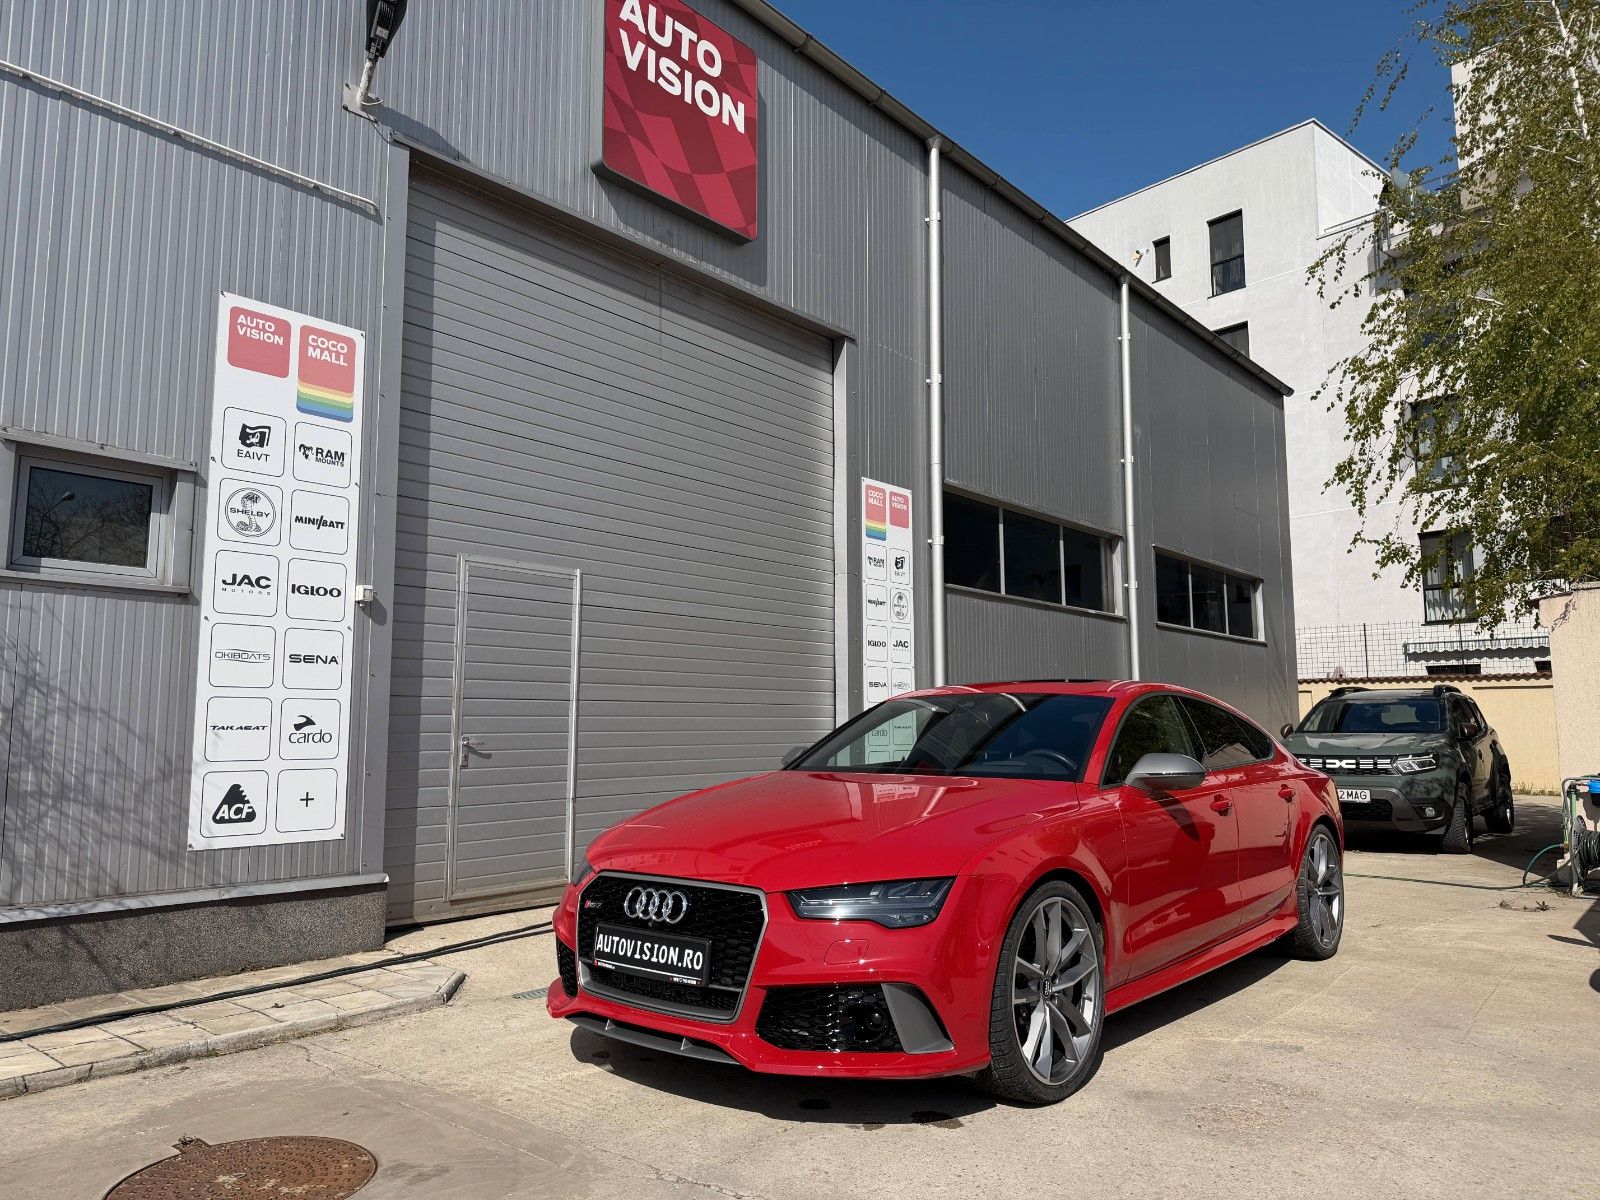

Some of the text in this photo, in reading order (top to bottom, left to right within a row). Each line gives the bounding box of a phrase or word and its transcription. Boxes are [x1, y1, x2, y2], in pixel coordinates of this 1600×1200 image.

[619, 0, 722, 78] AUTO
[619, 28, 745, 134] VISION
[237, 314, 275, 332] AUTO
[236, 324, 284, 346] VISION
[308, 334, 348, 354] COCO
[307, 346, 348, 367] MALL
[237, 448, 271, 462] EAIVT
[315, 446, 345, 462] RAM
[315, 456, 345, 468] MOUNTS
[229, 507, 271, 518] SHELBY
[221, 573, 272, 589] JAC
[291, 583, 342, 598] IGLOO
[892, 640, 909, 649] JAC
[288, 653, 339, 666] SENA
[288, 728, 333, 744] cardo
[1347, 789, 1368, 801] MAG
[596, 933, 703, 970] AUTOVISION.RO
